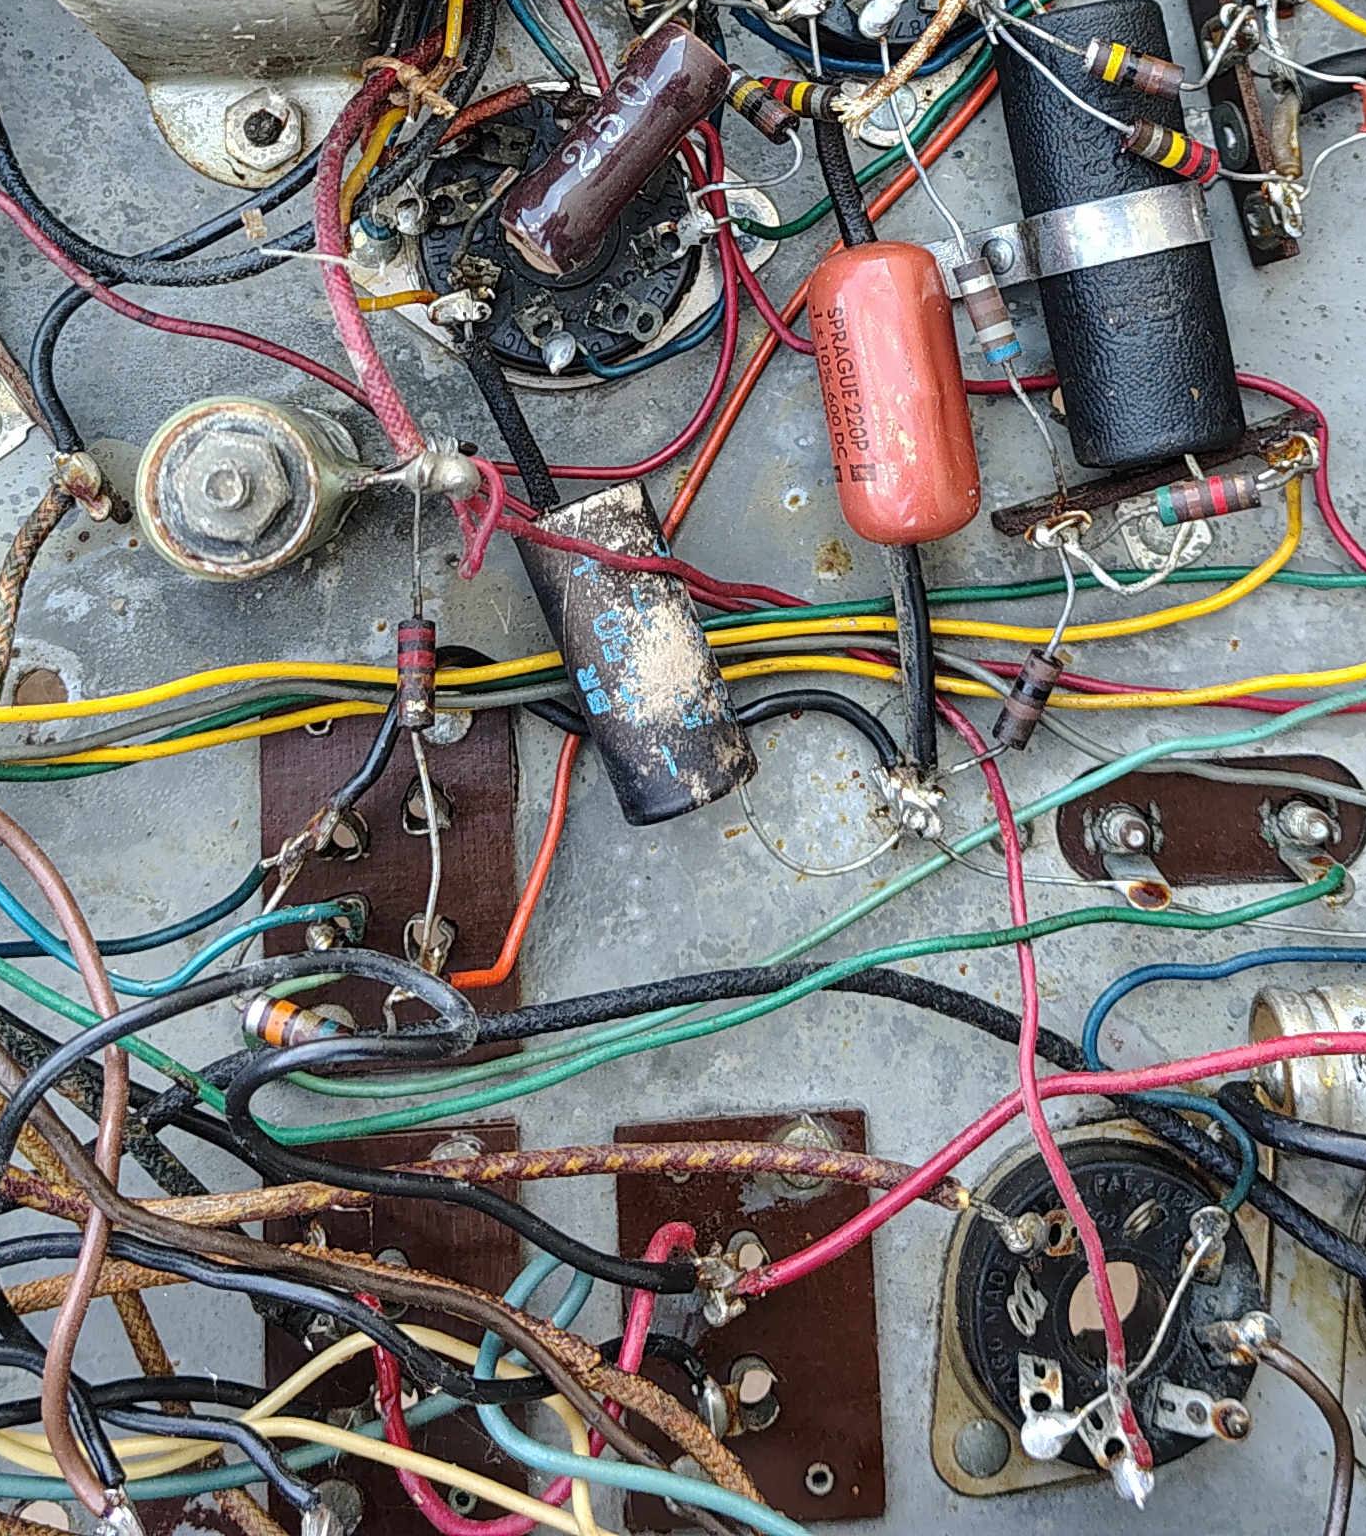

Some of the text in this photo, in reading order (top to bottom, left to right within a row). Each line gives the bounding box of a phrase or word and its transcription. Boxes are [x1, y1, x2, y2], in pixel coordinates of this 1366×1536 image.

[826, 305, 870, 453] SPRAGUE 220P
[833, 430, 849, 460] DC
